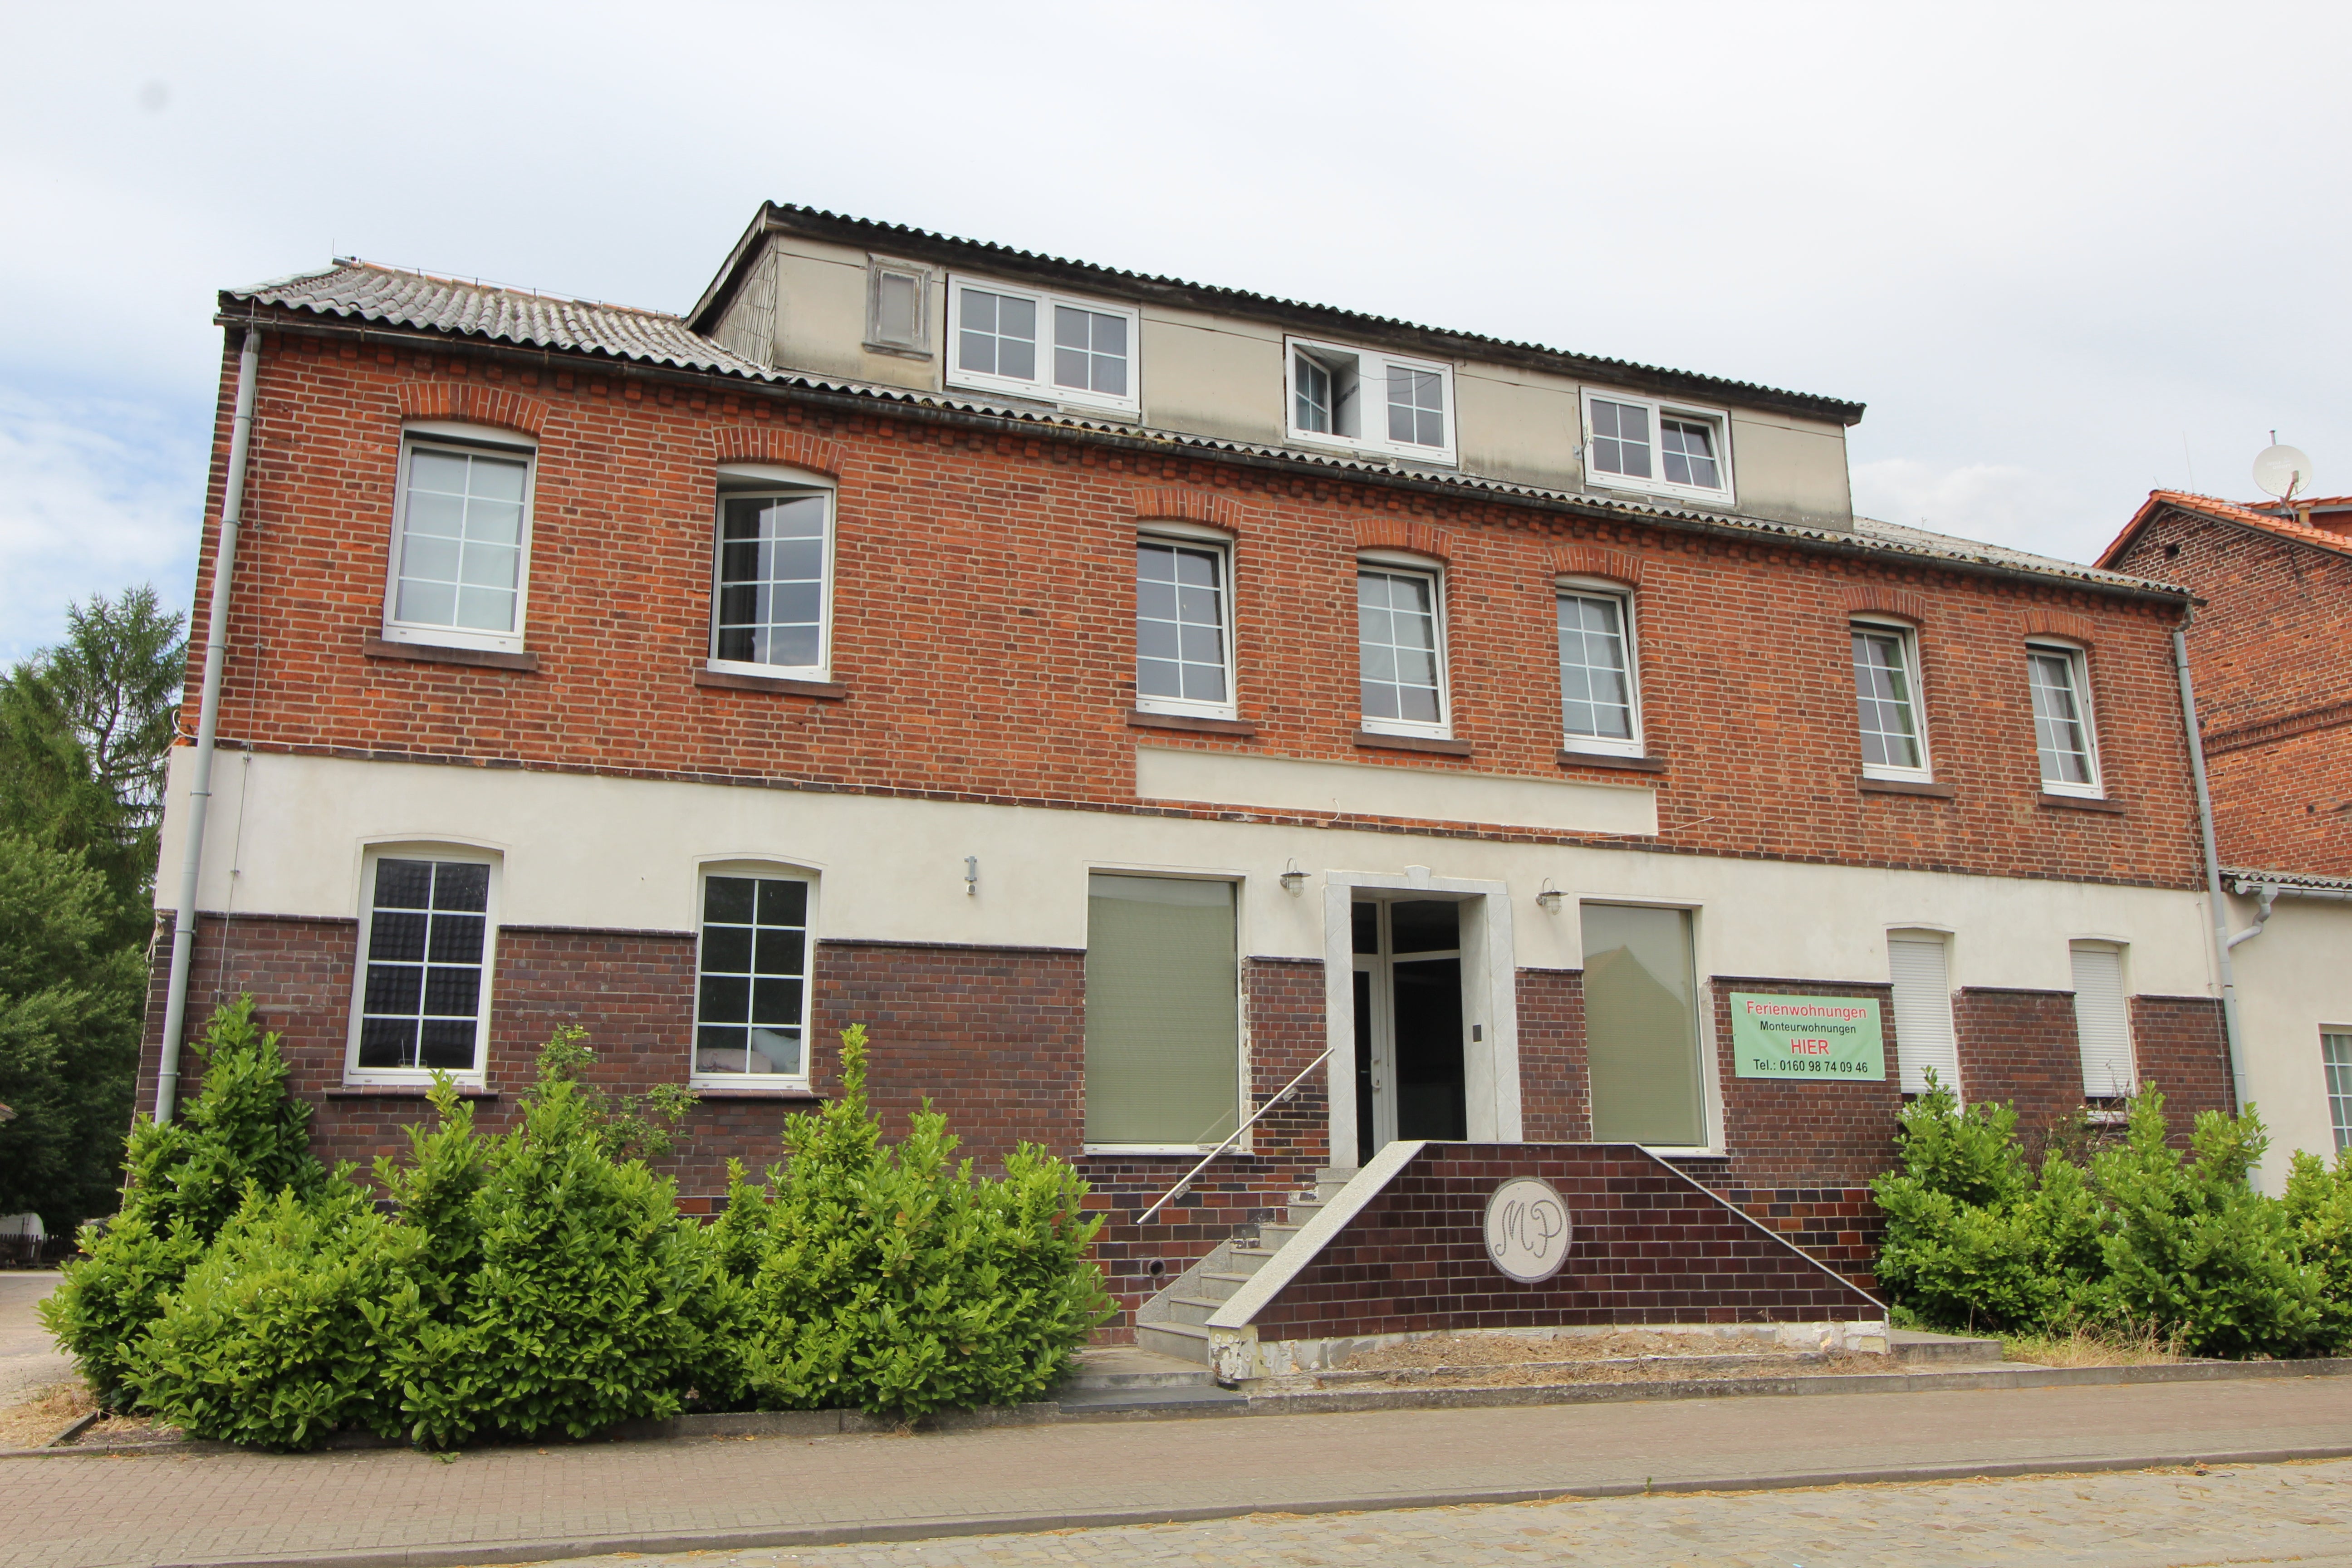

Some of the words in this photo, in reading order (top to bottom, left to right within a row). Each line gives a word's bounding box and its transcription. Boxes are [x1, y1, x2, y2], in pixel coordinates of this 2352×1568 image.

[1746, 1001, 1867, 1021] Ferienwohnungen
[1760, 1021, 1856, 1035] Monteurwohnungen
[1791, 1039, 1830, 1055] HIER
[1753, 1059, 1776, 1070] Tel.:
[1780, 1060, 1805, 1071] 0160
[1808, 1061, 1821, 1072] 98
[1824, 1061, 1837, 1072] 74
[1840, 1062, 1852, 1072] 09
[1855, 1062, 1868, 1073] 46
